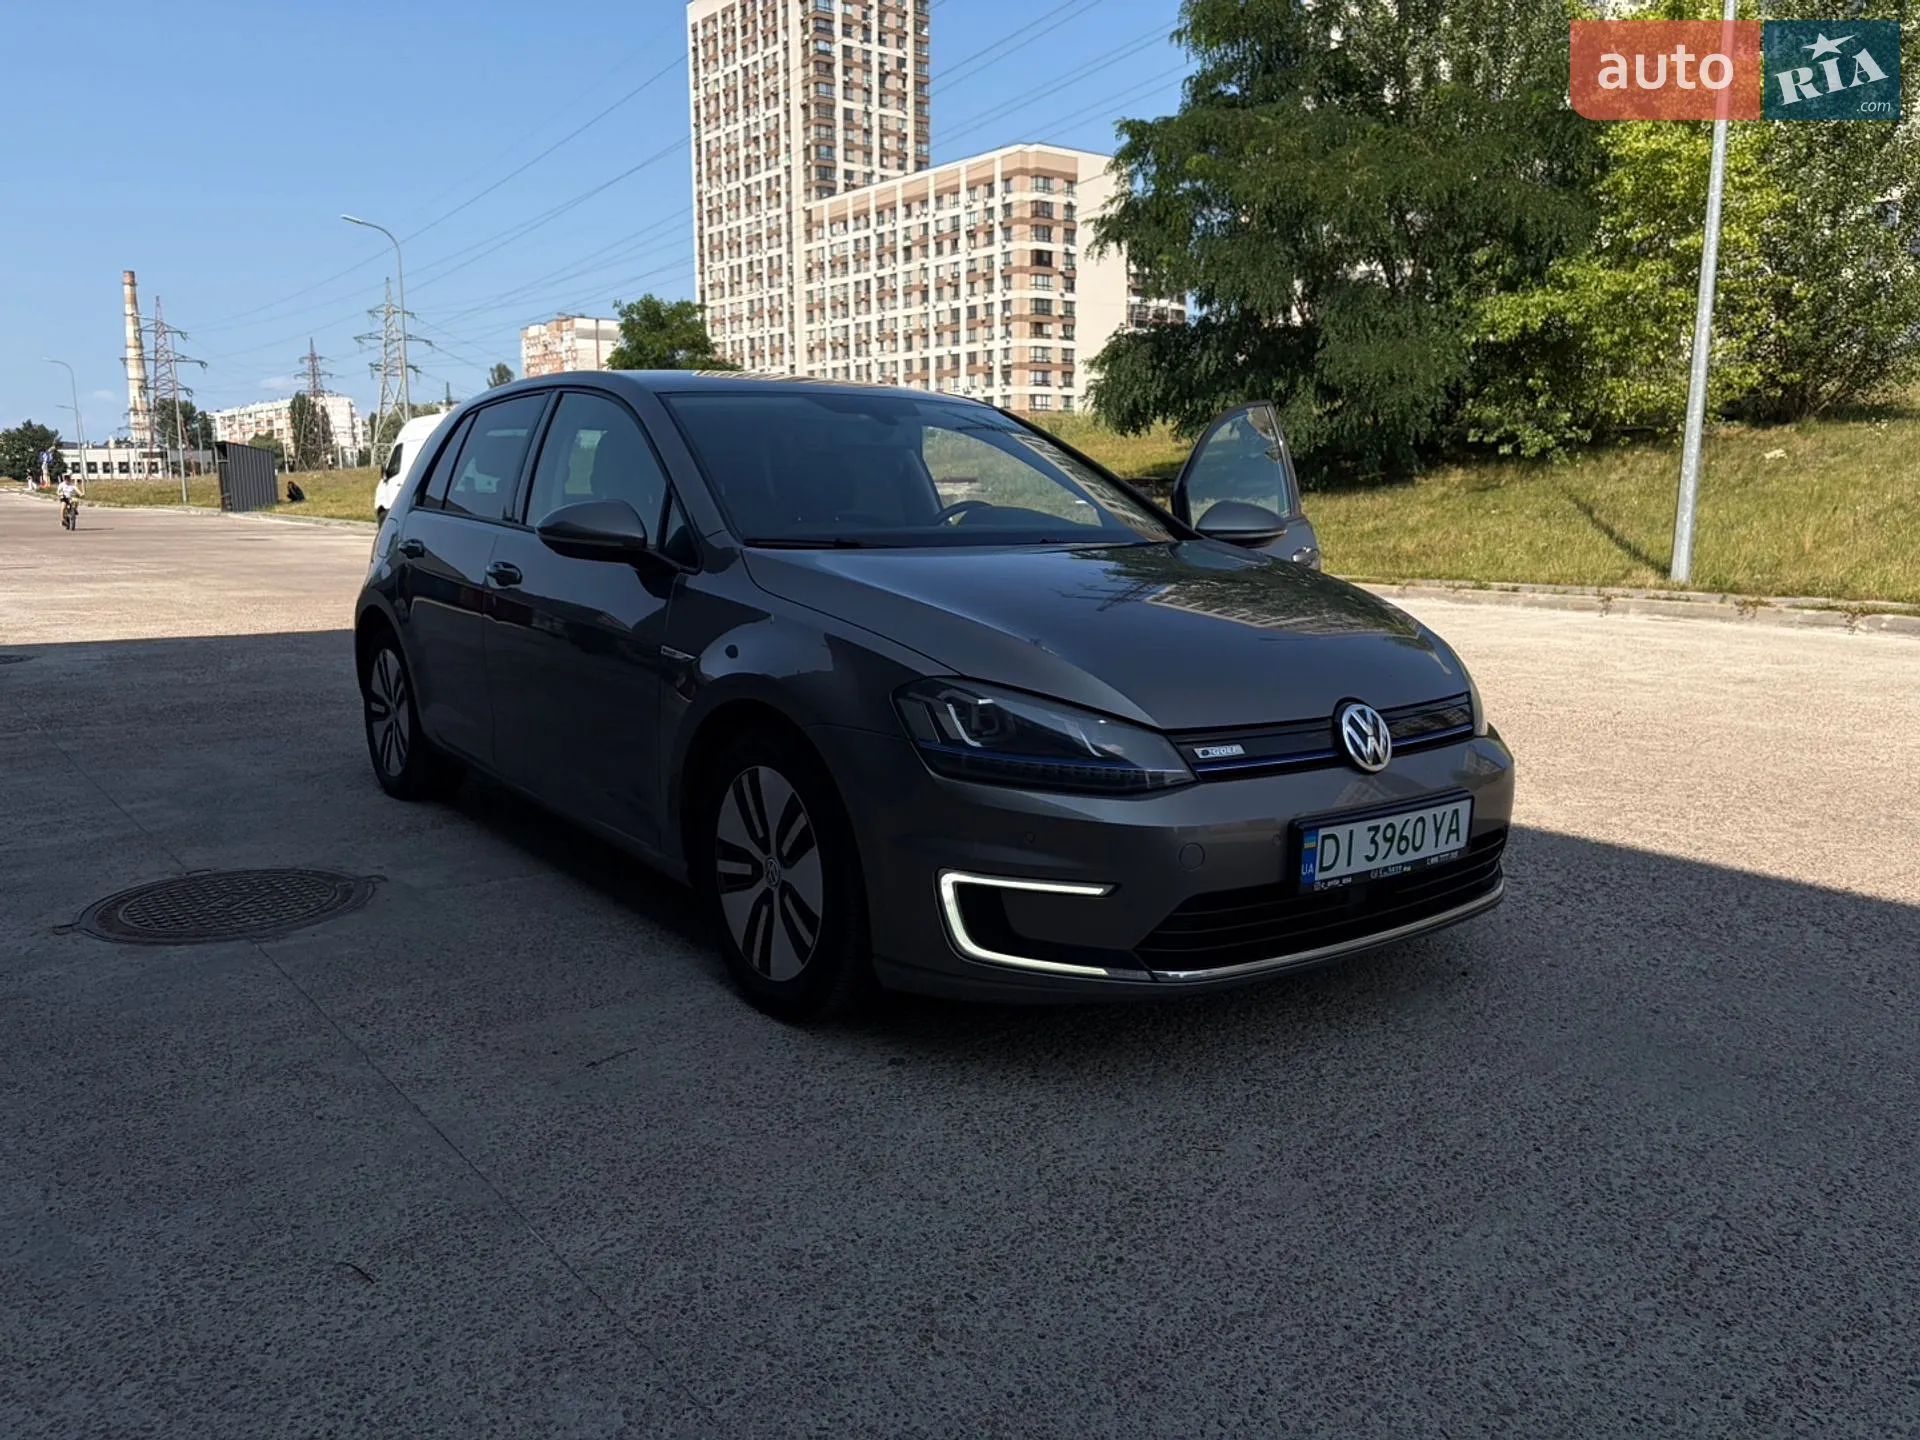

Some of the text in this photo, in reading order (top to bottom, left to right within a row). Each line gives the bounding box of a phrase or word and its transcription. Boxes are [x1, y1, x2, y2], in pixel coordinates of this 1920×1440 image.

[1318, 808, 1460, 873] DI 3960 YA
[1301, 862, 1315, 876] UA
